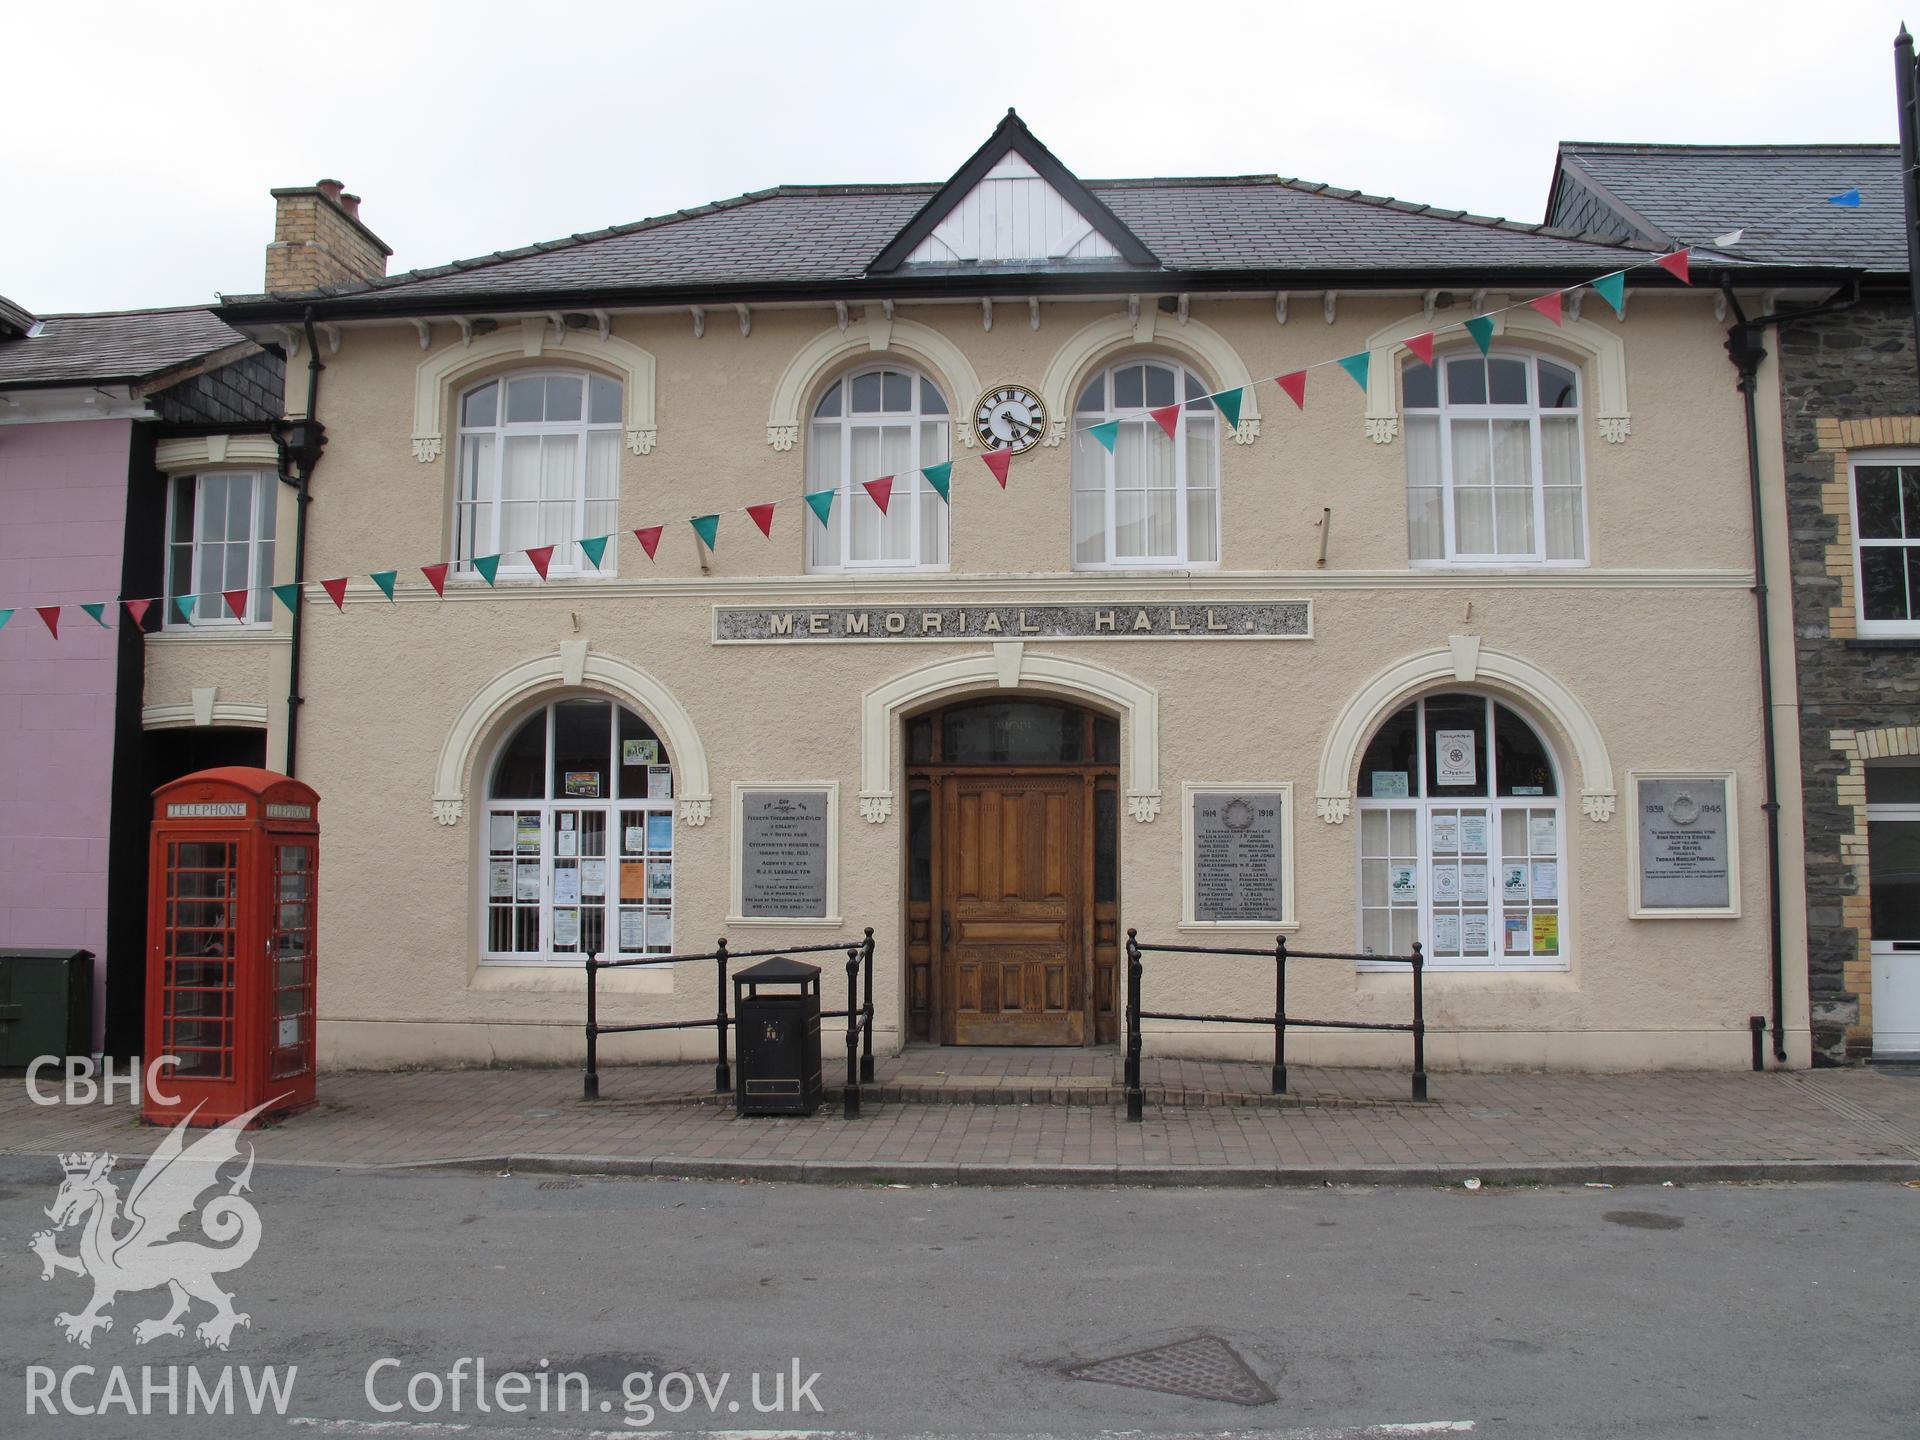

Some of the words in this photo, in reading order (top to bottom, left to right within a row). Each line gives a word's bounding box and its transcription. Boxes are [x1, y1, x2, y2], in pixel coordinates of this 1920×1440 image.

[770, 611, 1040, 634] MEMORIAL
[170, 804, 243, 816] TELEPHONE
[268, 804, 309, 817] TELEPHONE
[1258, 809, 1274, 817] 1918
